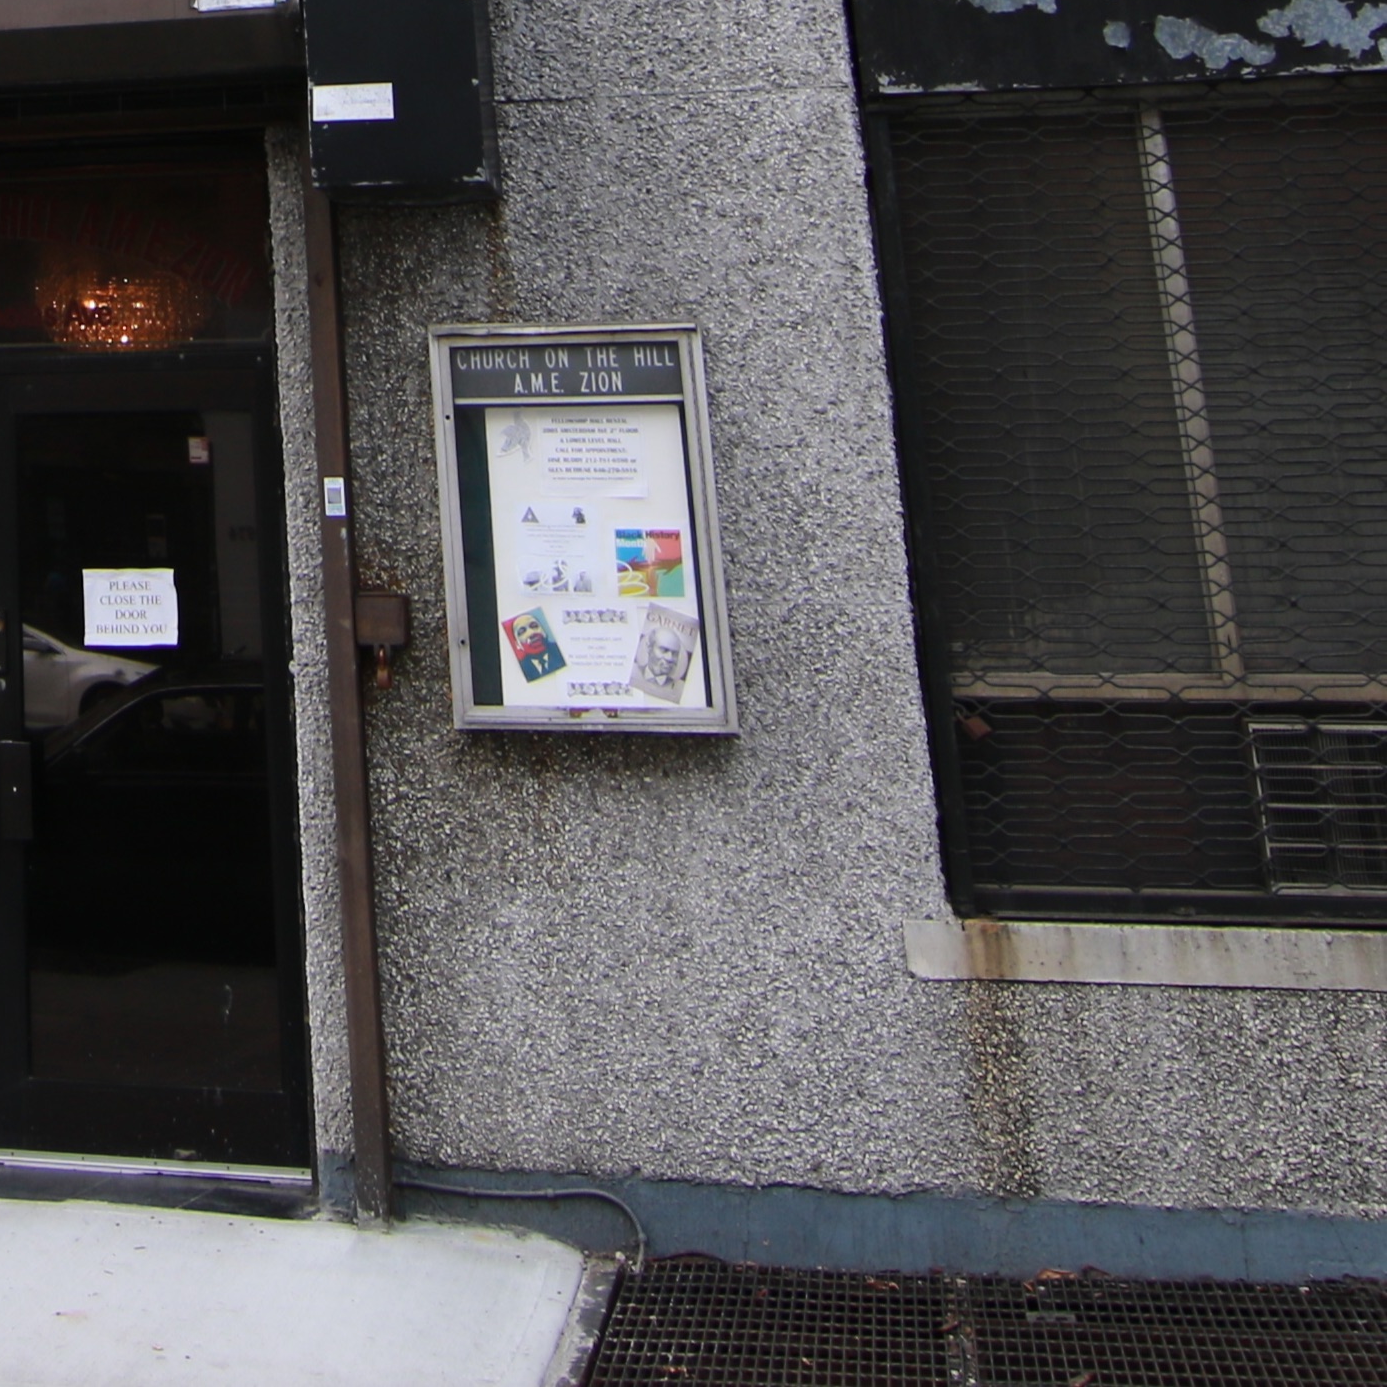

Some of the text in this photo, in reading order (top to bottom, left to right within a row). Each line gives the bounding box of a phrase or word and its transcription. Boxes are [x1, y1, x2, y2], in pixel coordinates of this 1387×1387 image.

[457, 346, 675, 370] CHURCH ON THE HILL
[514, 371, 623, 394] A.M.E. ZION
[616, 529, 680, 542] Black History
[109, 580, 151, 591] PLEASE
[99, 595, 162, 605] CLOSE THE
[115, 609, 147, 620] DOOR
[96, 624, 168, 634] BEHIND YOU
[646, 612, 697, 636] GARNET
